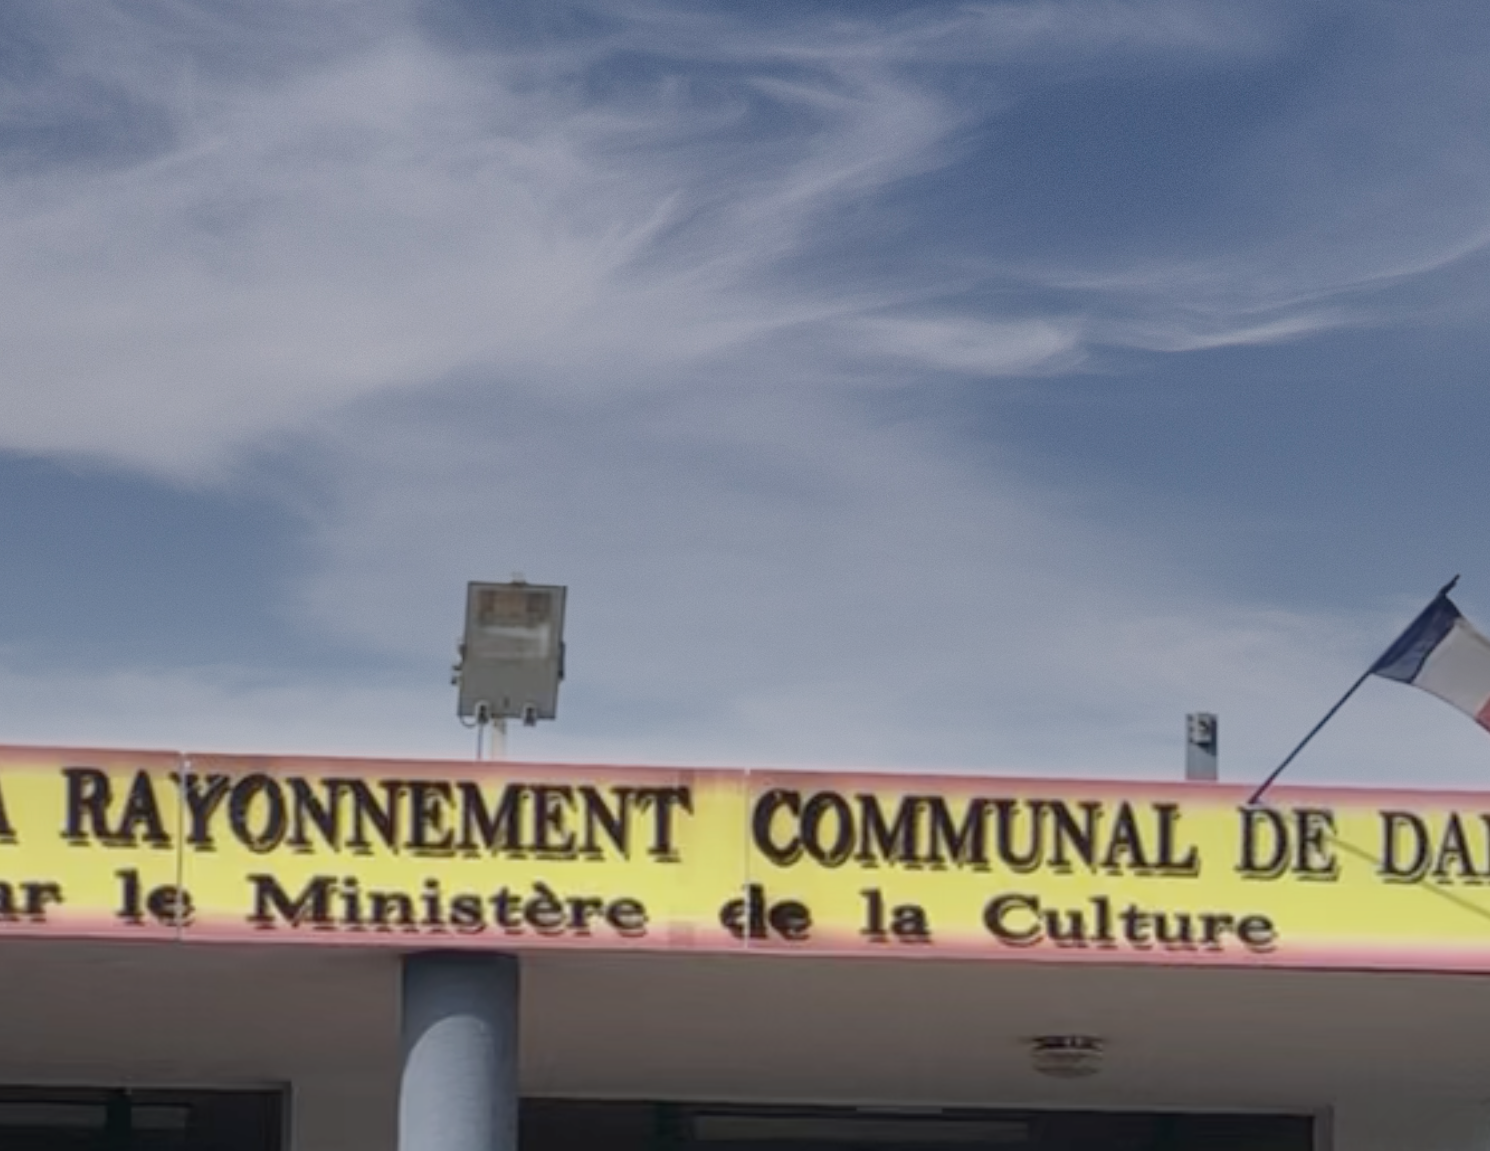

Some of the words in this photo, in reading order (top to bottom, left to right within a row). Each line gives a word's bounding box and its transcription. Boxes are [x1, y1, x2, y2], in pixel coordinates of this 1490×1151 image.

[61, 766, 694, 864] RAYONNEMENT
[751, 789, 1200, 876] COMMUNAL
[1234, 804, 1340, 882] DE
[114, 868, 196, 927] le
[247, 872, 650, 939] Ministère
[717, 882, 812, 942] de
[859, 888, 932, 943] la
[983, 892, 1277, 954] Culture
